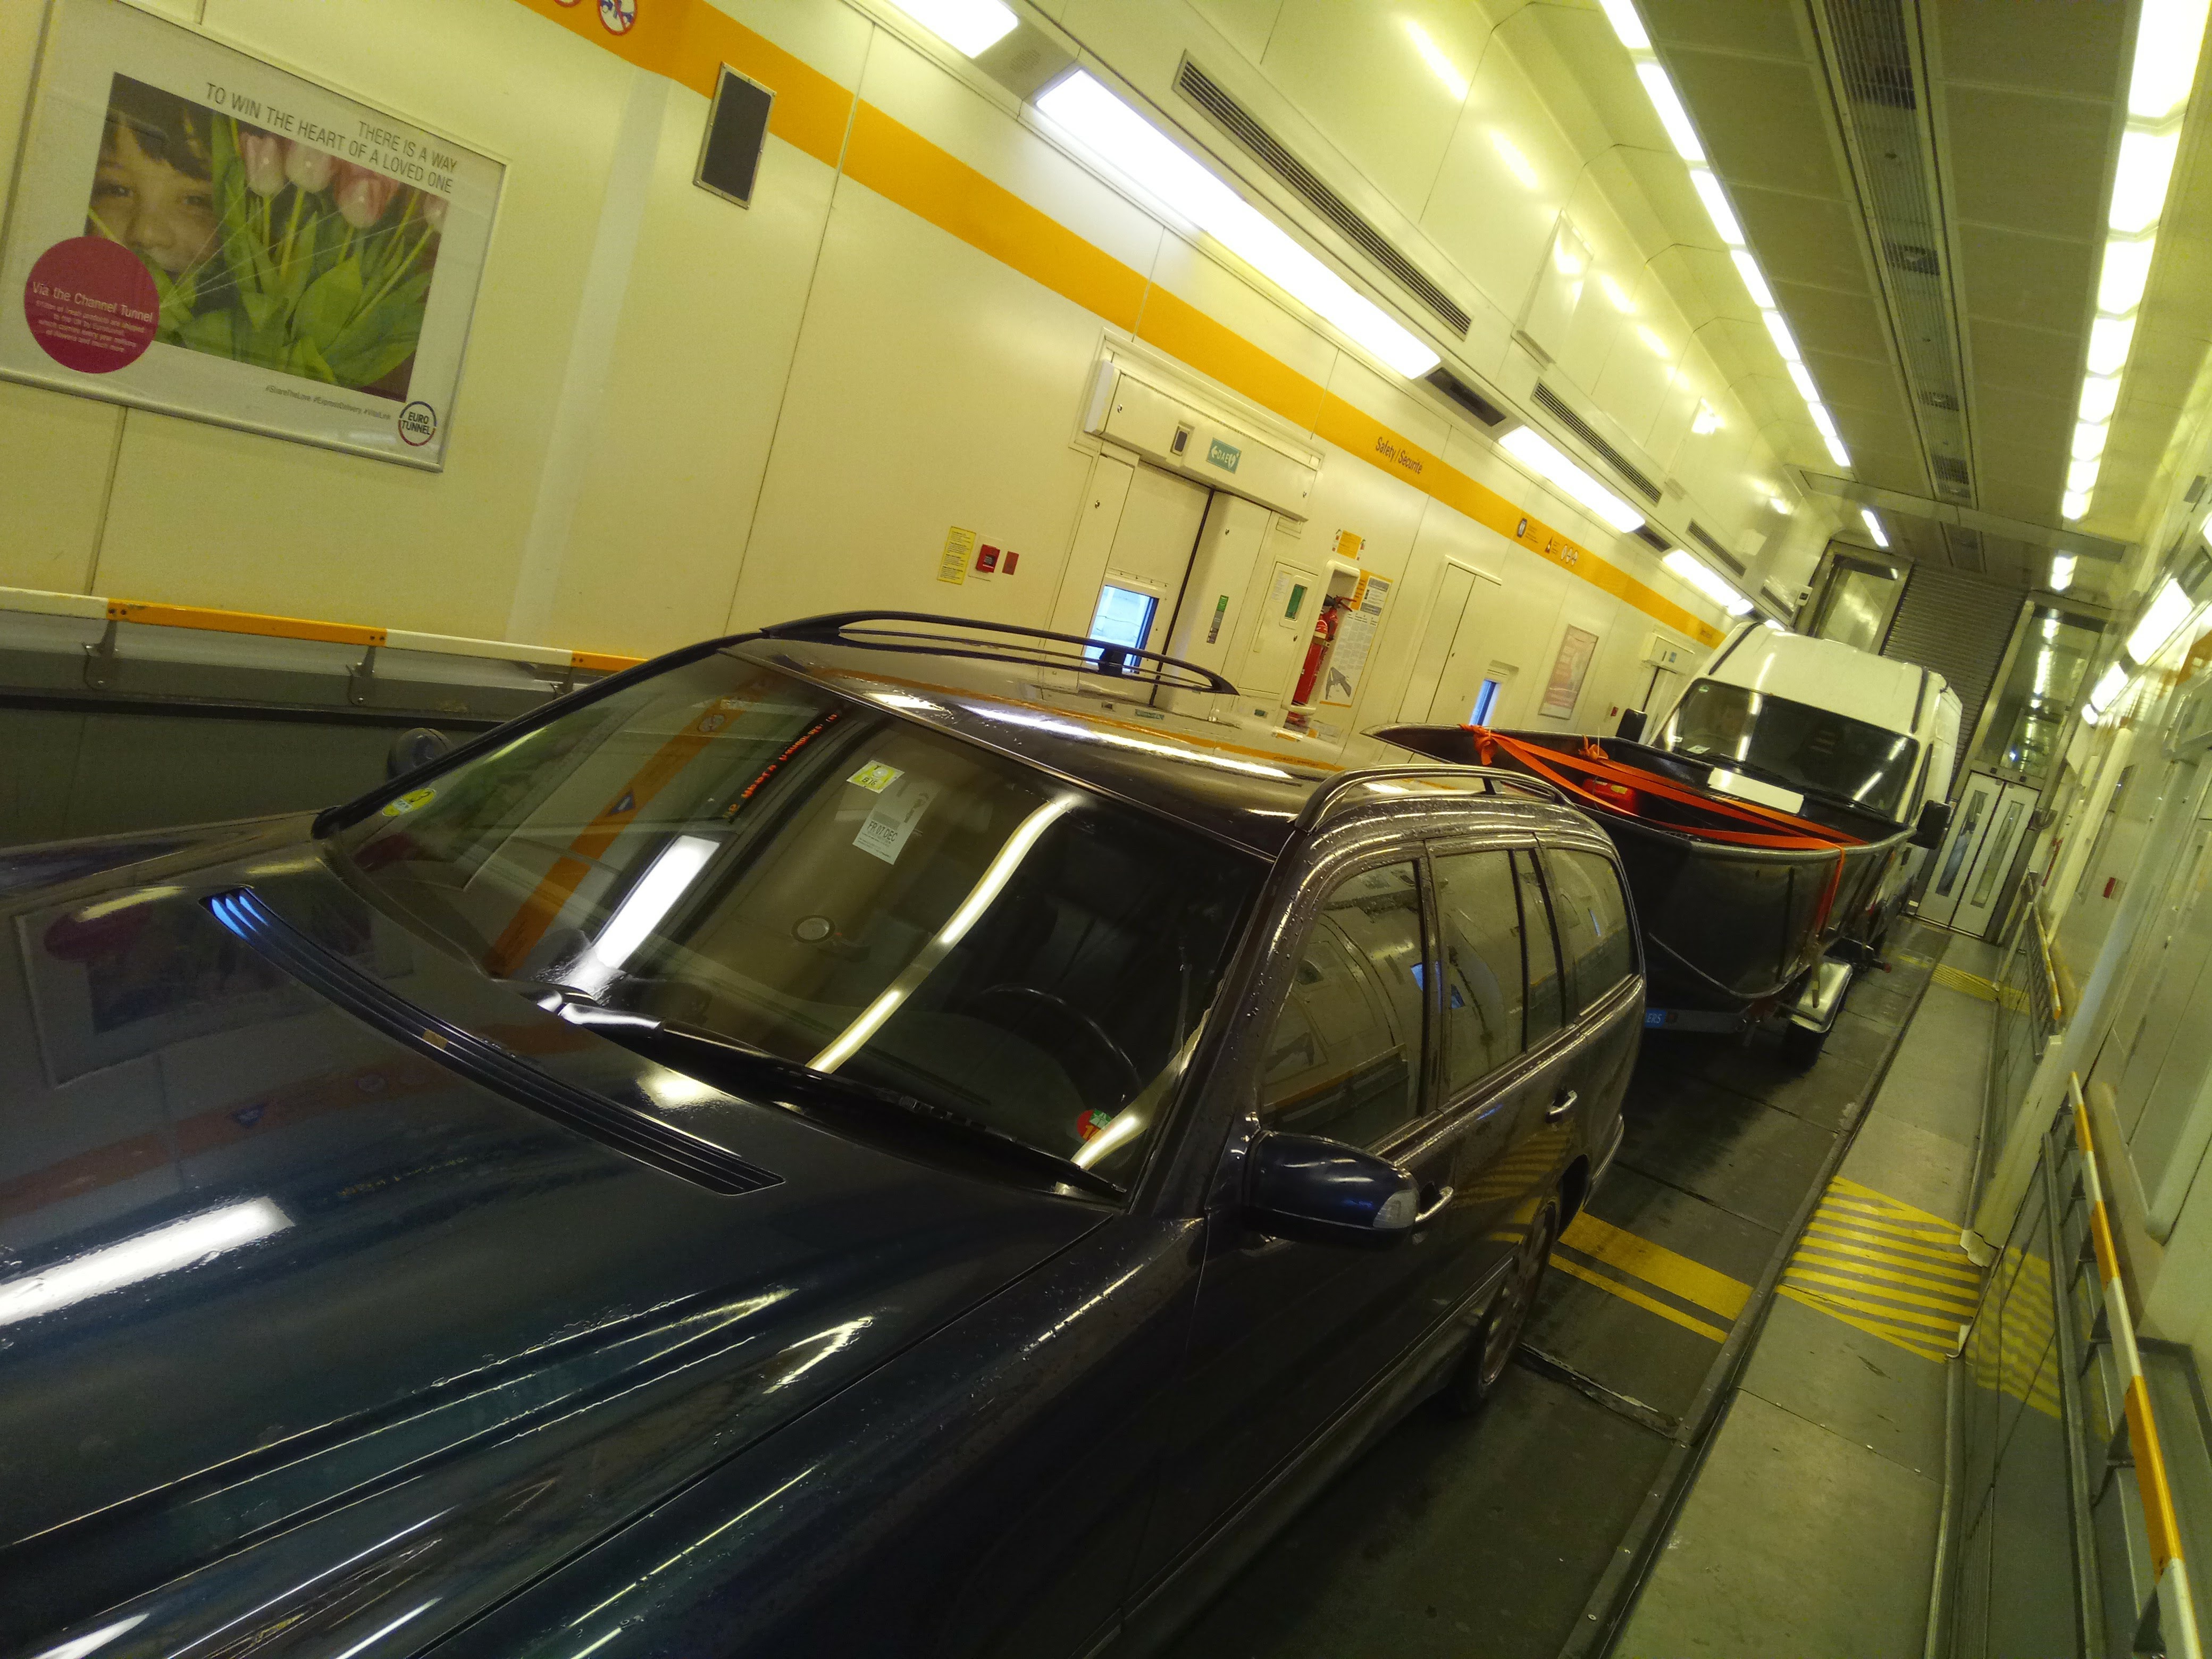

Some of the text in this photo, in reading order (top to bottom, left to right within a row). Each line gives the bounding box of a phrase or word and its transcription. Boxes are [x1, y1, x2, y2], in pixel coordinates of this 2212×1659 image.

[207, 82, 454, 194] TO WIN THE HEART OF A LOVED ONE
[359, 121, 458, 173] THERE IS A WAY
[33, 281, 49, 296] Via
[53, 287, 71, 301] the
[74, 293, 118, 313] Channel
[121, 304, 153, 323] Tunnel
[402, 420, 431, 435] TUNNEL
[408, 412, 429, 425] EURO
[1217, 449, 1230, 463] DAE
[1376, 437, 1396, 462] Safety
[1398, 449, 1423, 474] Sécurité
[867, 820, 898, 842] FR 07 DEC
